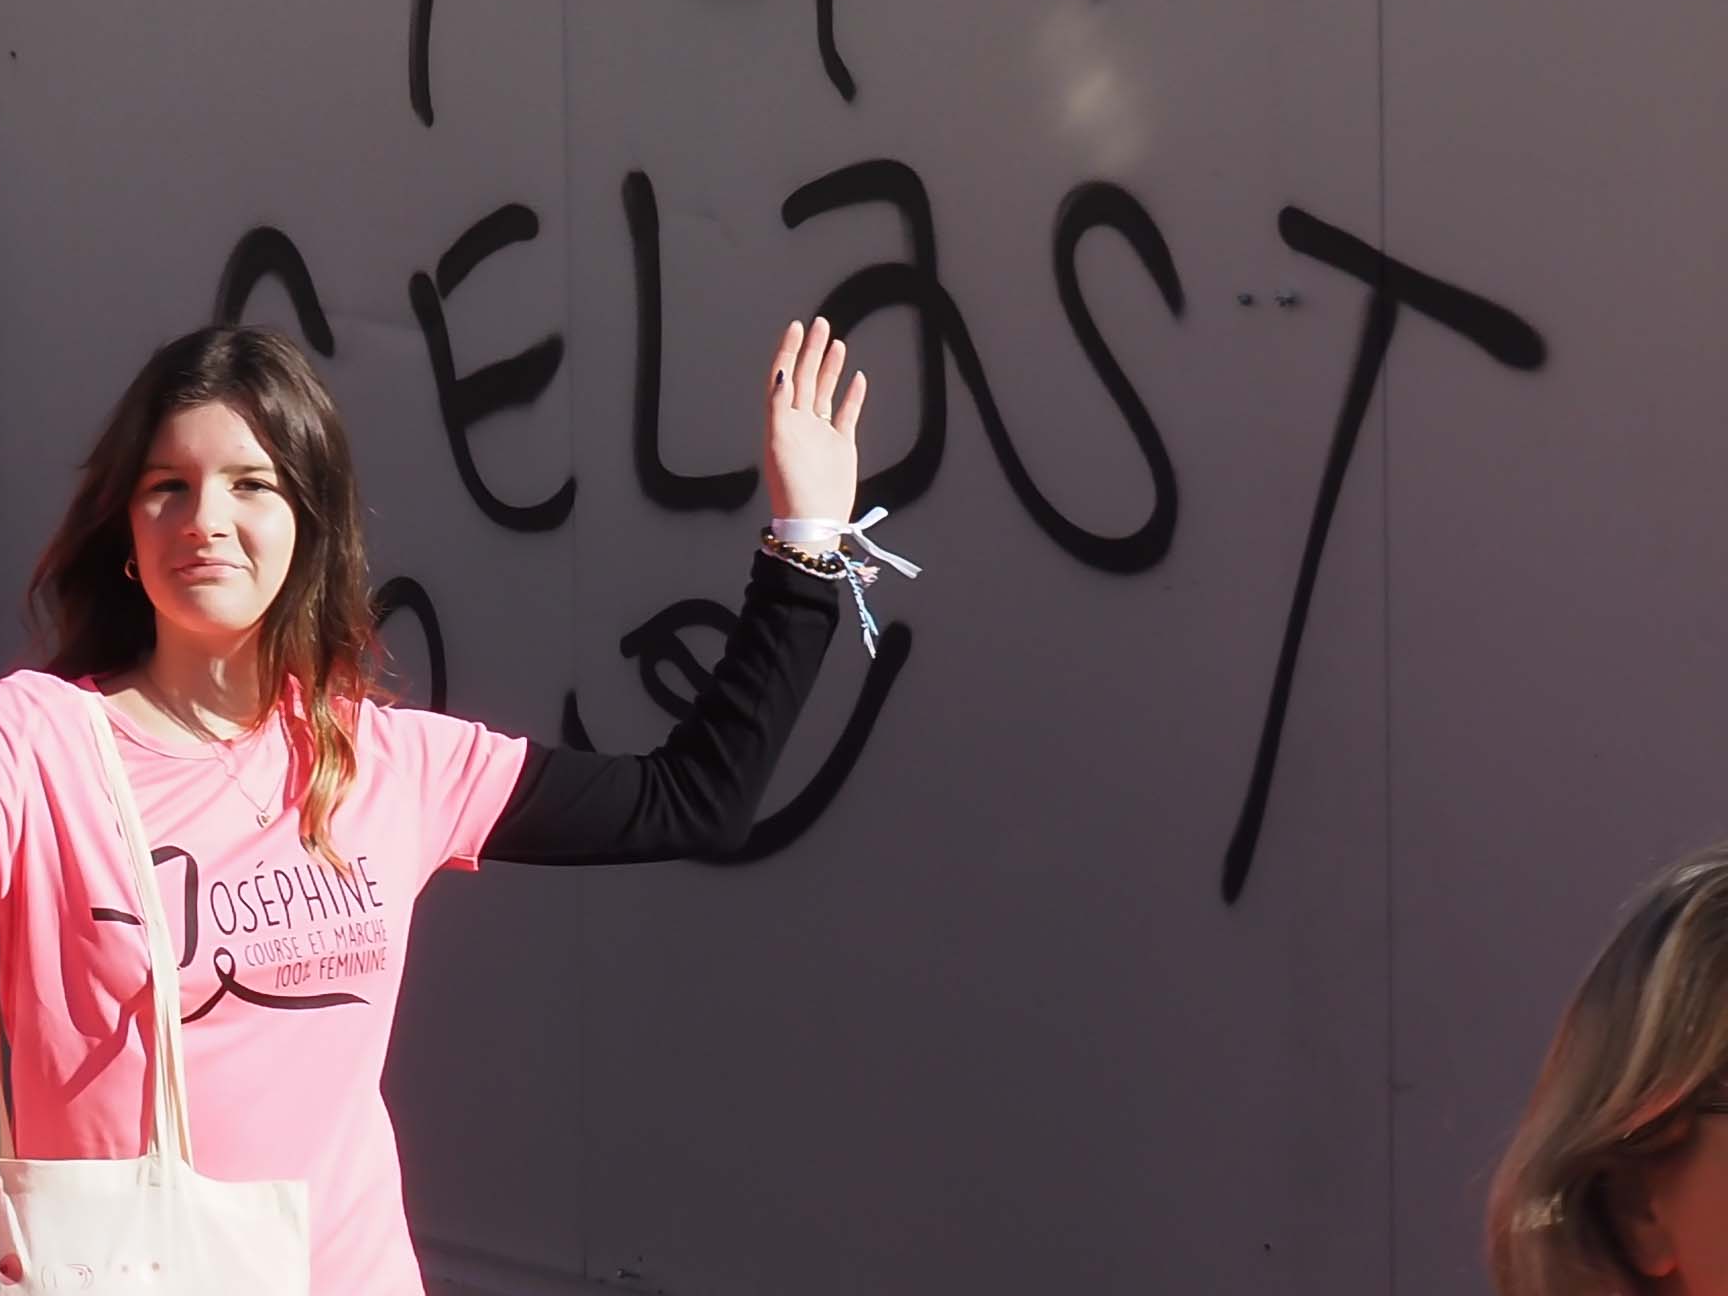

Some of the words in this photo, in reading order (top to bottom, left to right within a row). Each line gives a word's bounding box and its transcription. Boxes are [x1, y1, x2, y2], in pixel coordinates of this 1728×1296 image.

[243, 934, 301, 968] COURSE
[310, 929, 329, 956] ET
[333, 917, 389, 948] MARCHE
[318, 946, 388, 981] FÉMININE
